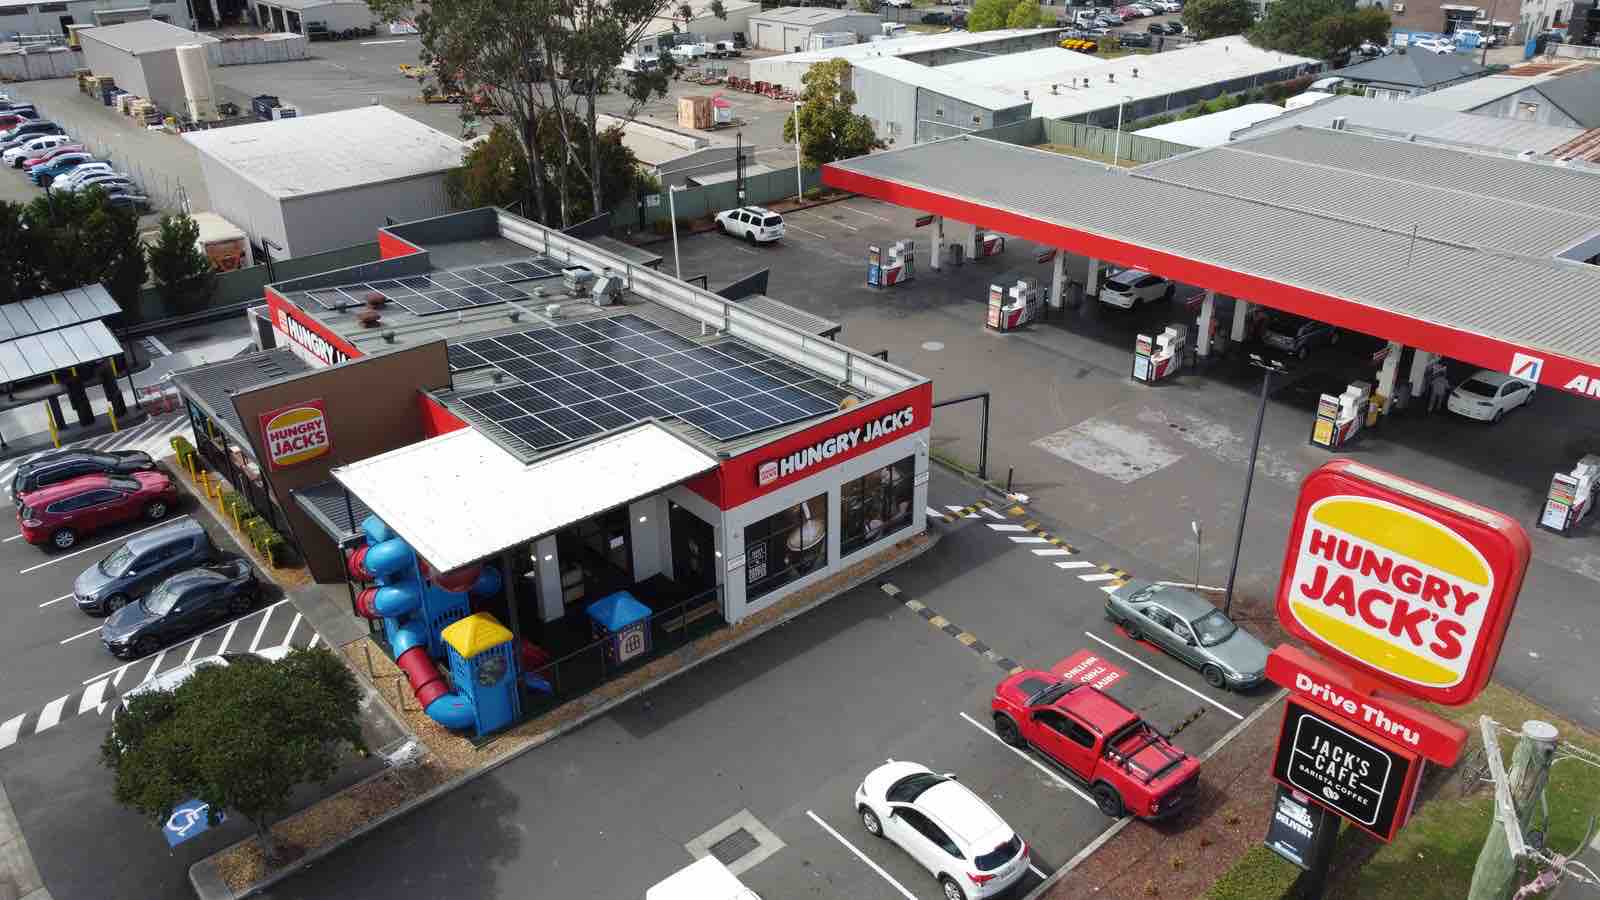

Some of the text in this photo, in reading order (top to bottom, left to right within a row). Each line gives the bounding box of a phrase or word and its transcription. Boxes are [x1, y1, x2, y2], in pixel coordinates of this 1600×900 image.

[287, 316, 334, 366] HUNGRY
[270, 419, 323, 442] HUNGRY
[780, 428, 861, 477] HUNGRY
[1309, 529, 1480, 616] HUNGRY
[1300, 565, 1467, 660] JACK'S
[1295, 673, 1421, 746] Drive Thru
[1311, 736, 1370, 777] JACK'S
[1315, 754, 1360, 790] CAFE
[1298, 764, 1370, 806] BARISTA COFFEE
[1275, 811, 1313, 839] DELIVERY
